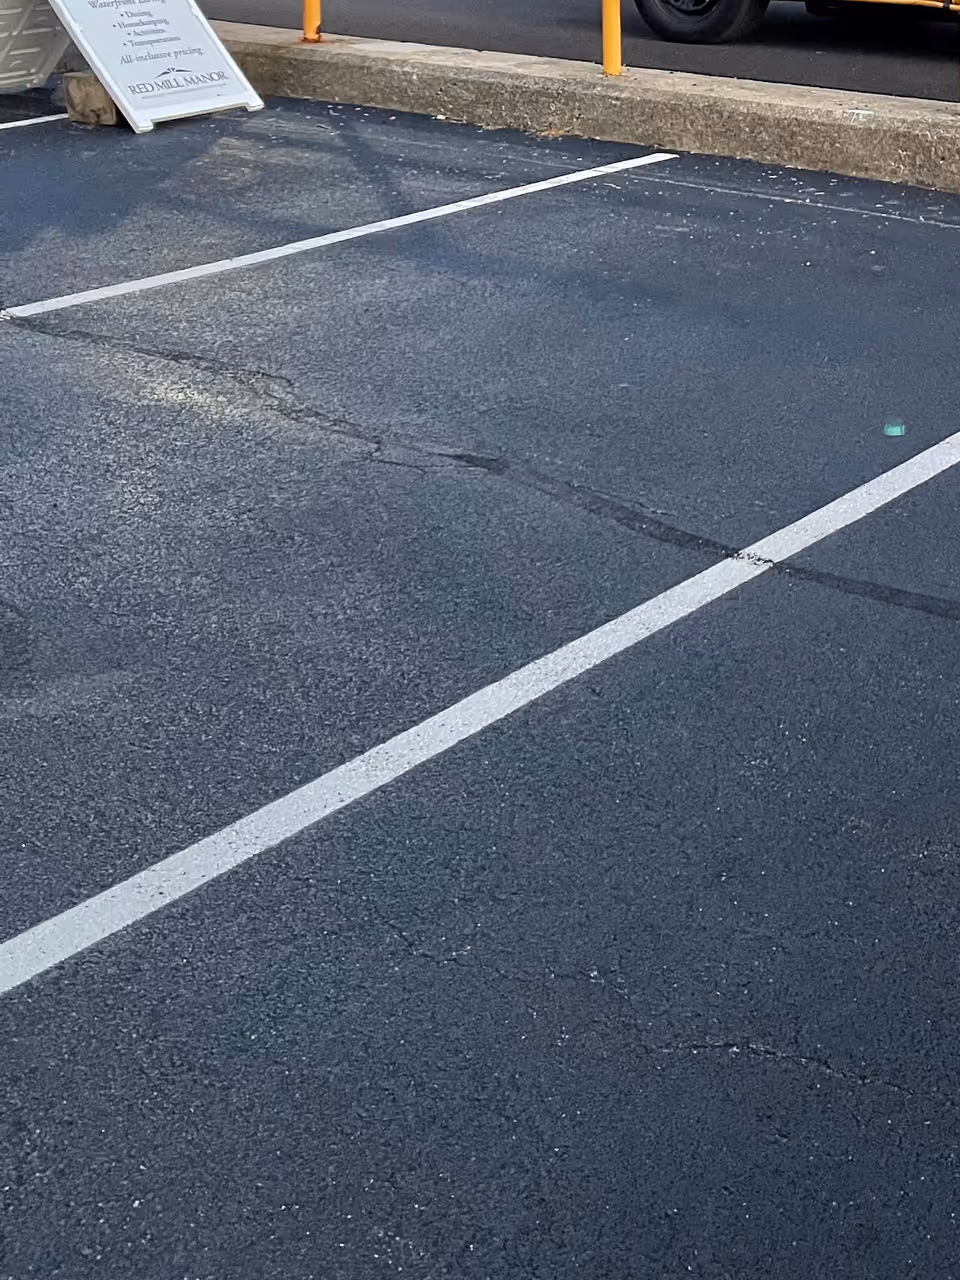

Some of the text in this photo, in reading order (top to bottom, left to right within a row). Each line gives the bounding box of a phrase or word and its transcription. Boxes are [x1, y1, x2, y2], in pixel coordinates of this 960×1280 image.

[120, 47, 204, 65] All-inclusive pricing
[128, 82, 155, 95] RED
[154, 78, 185, 91] MILL
[183, 71, 229, 87] MANOR
